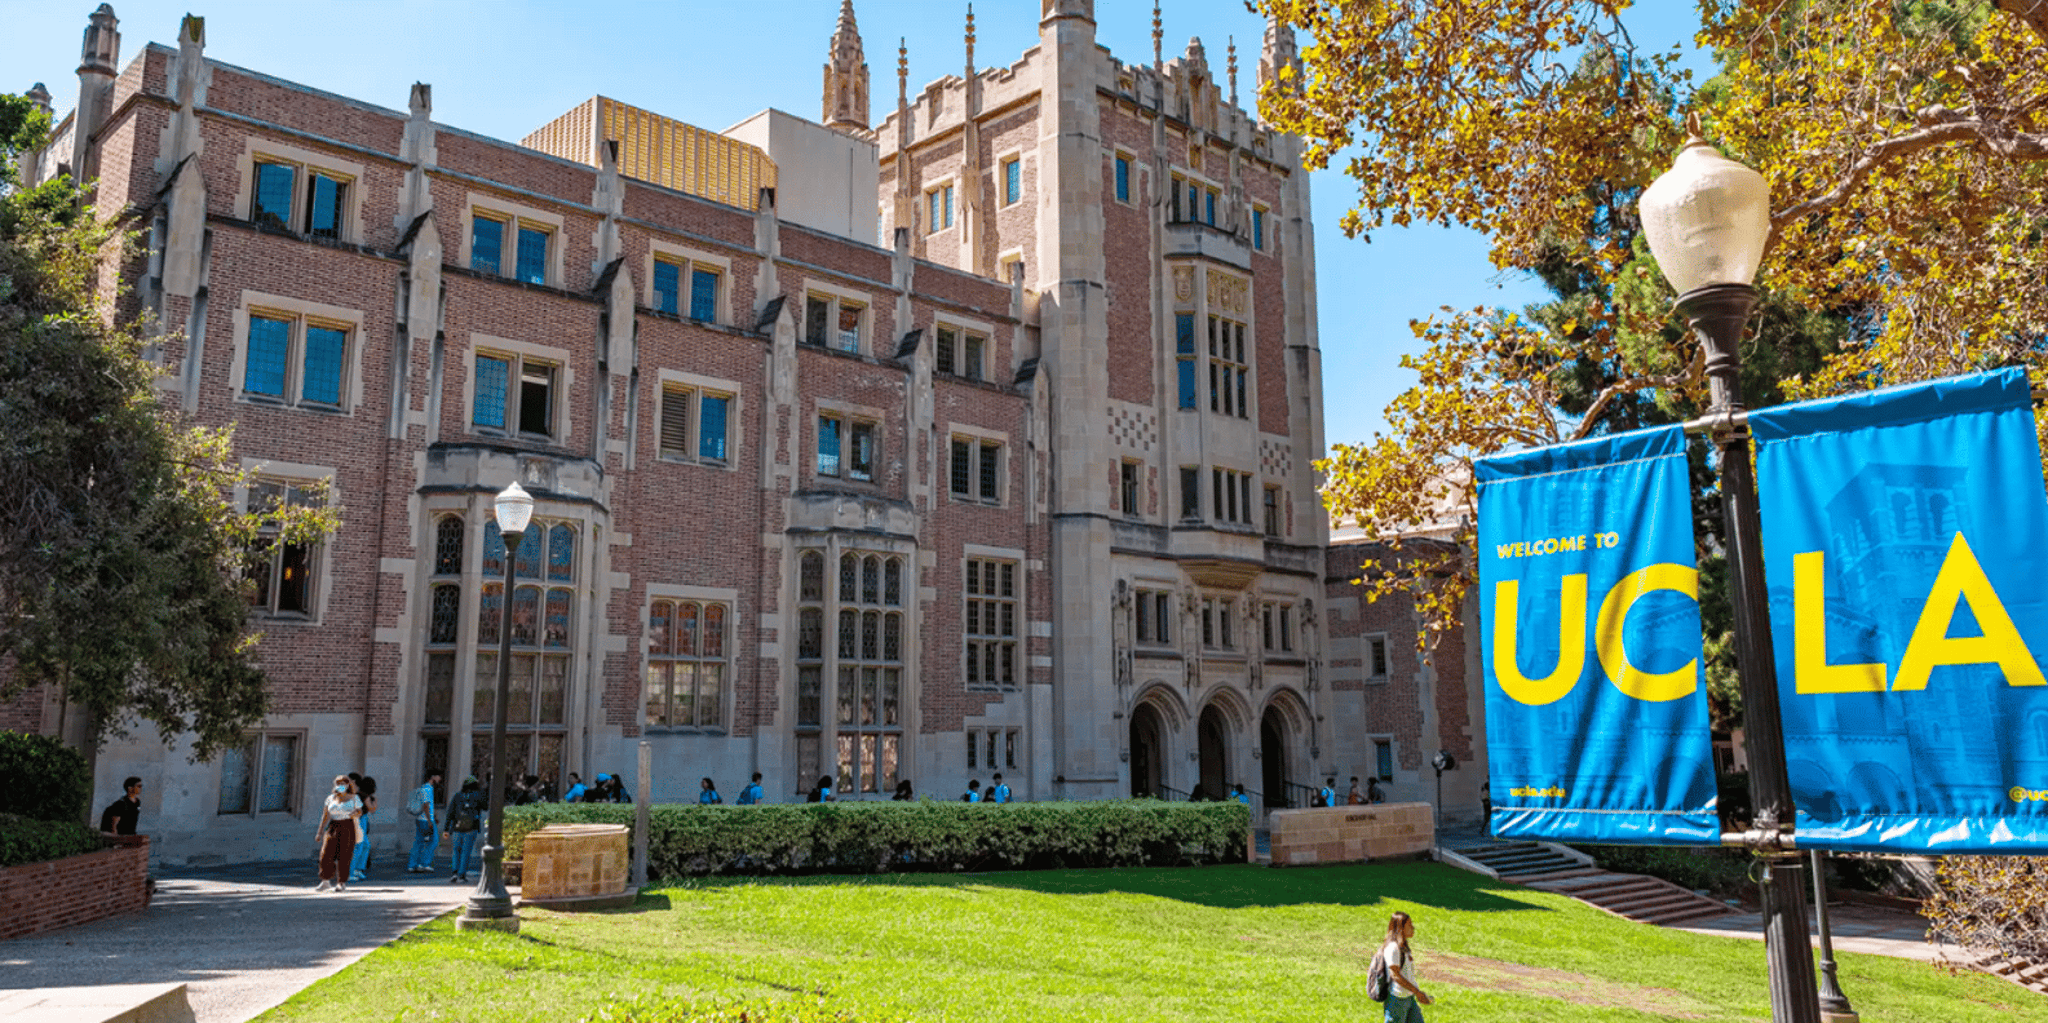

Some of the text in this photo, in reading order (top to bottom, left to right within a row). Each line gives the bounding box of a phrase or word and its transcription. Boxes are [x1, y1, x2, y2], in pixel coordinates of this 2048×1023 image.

[1496, 531, 1619, 559] WELCOME TO
[1493, 562, 1698, 706] UC
[1793, 531, 2048, 695] LA
[1509, 784, 1566, 798] ucla.edu
